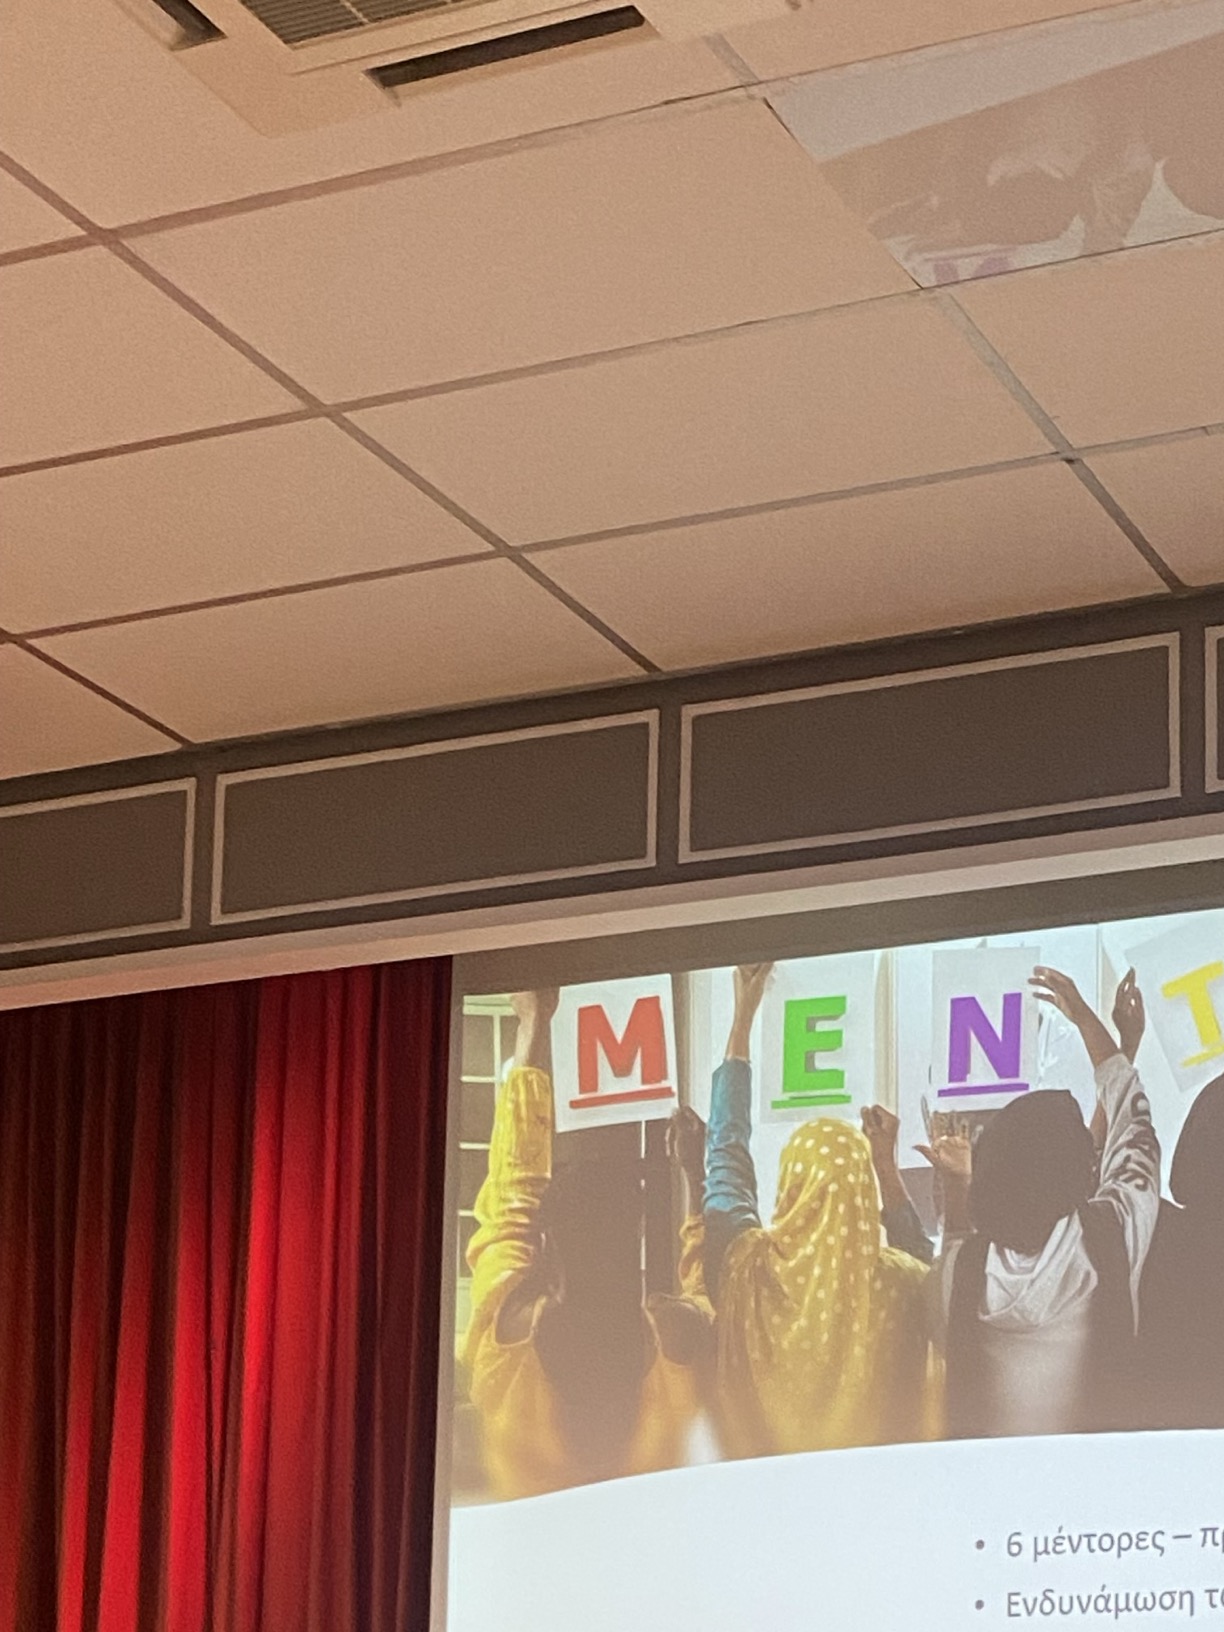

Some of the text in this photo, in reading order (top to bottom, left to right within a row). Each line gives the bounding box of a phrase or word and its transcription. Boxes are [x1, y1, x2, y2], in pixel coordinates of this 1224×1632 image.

[576, 995, 673, 1095] M
[782, 995, 848, 1093] E
[948, 991, 1023, 1083] N
[1006, 1531, 1023, 1558] 6
[1033, 1525, 1166, 1563] μέντορες
[1006, 1583, 1195, 1621] Ενδυνάμωση
